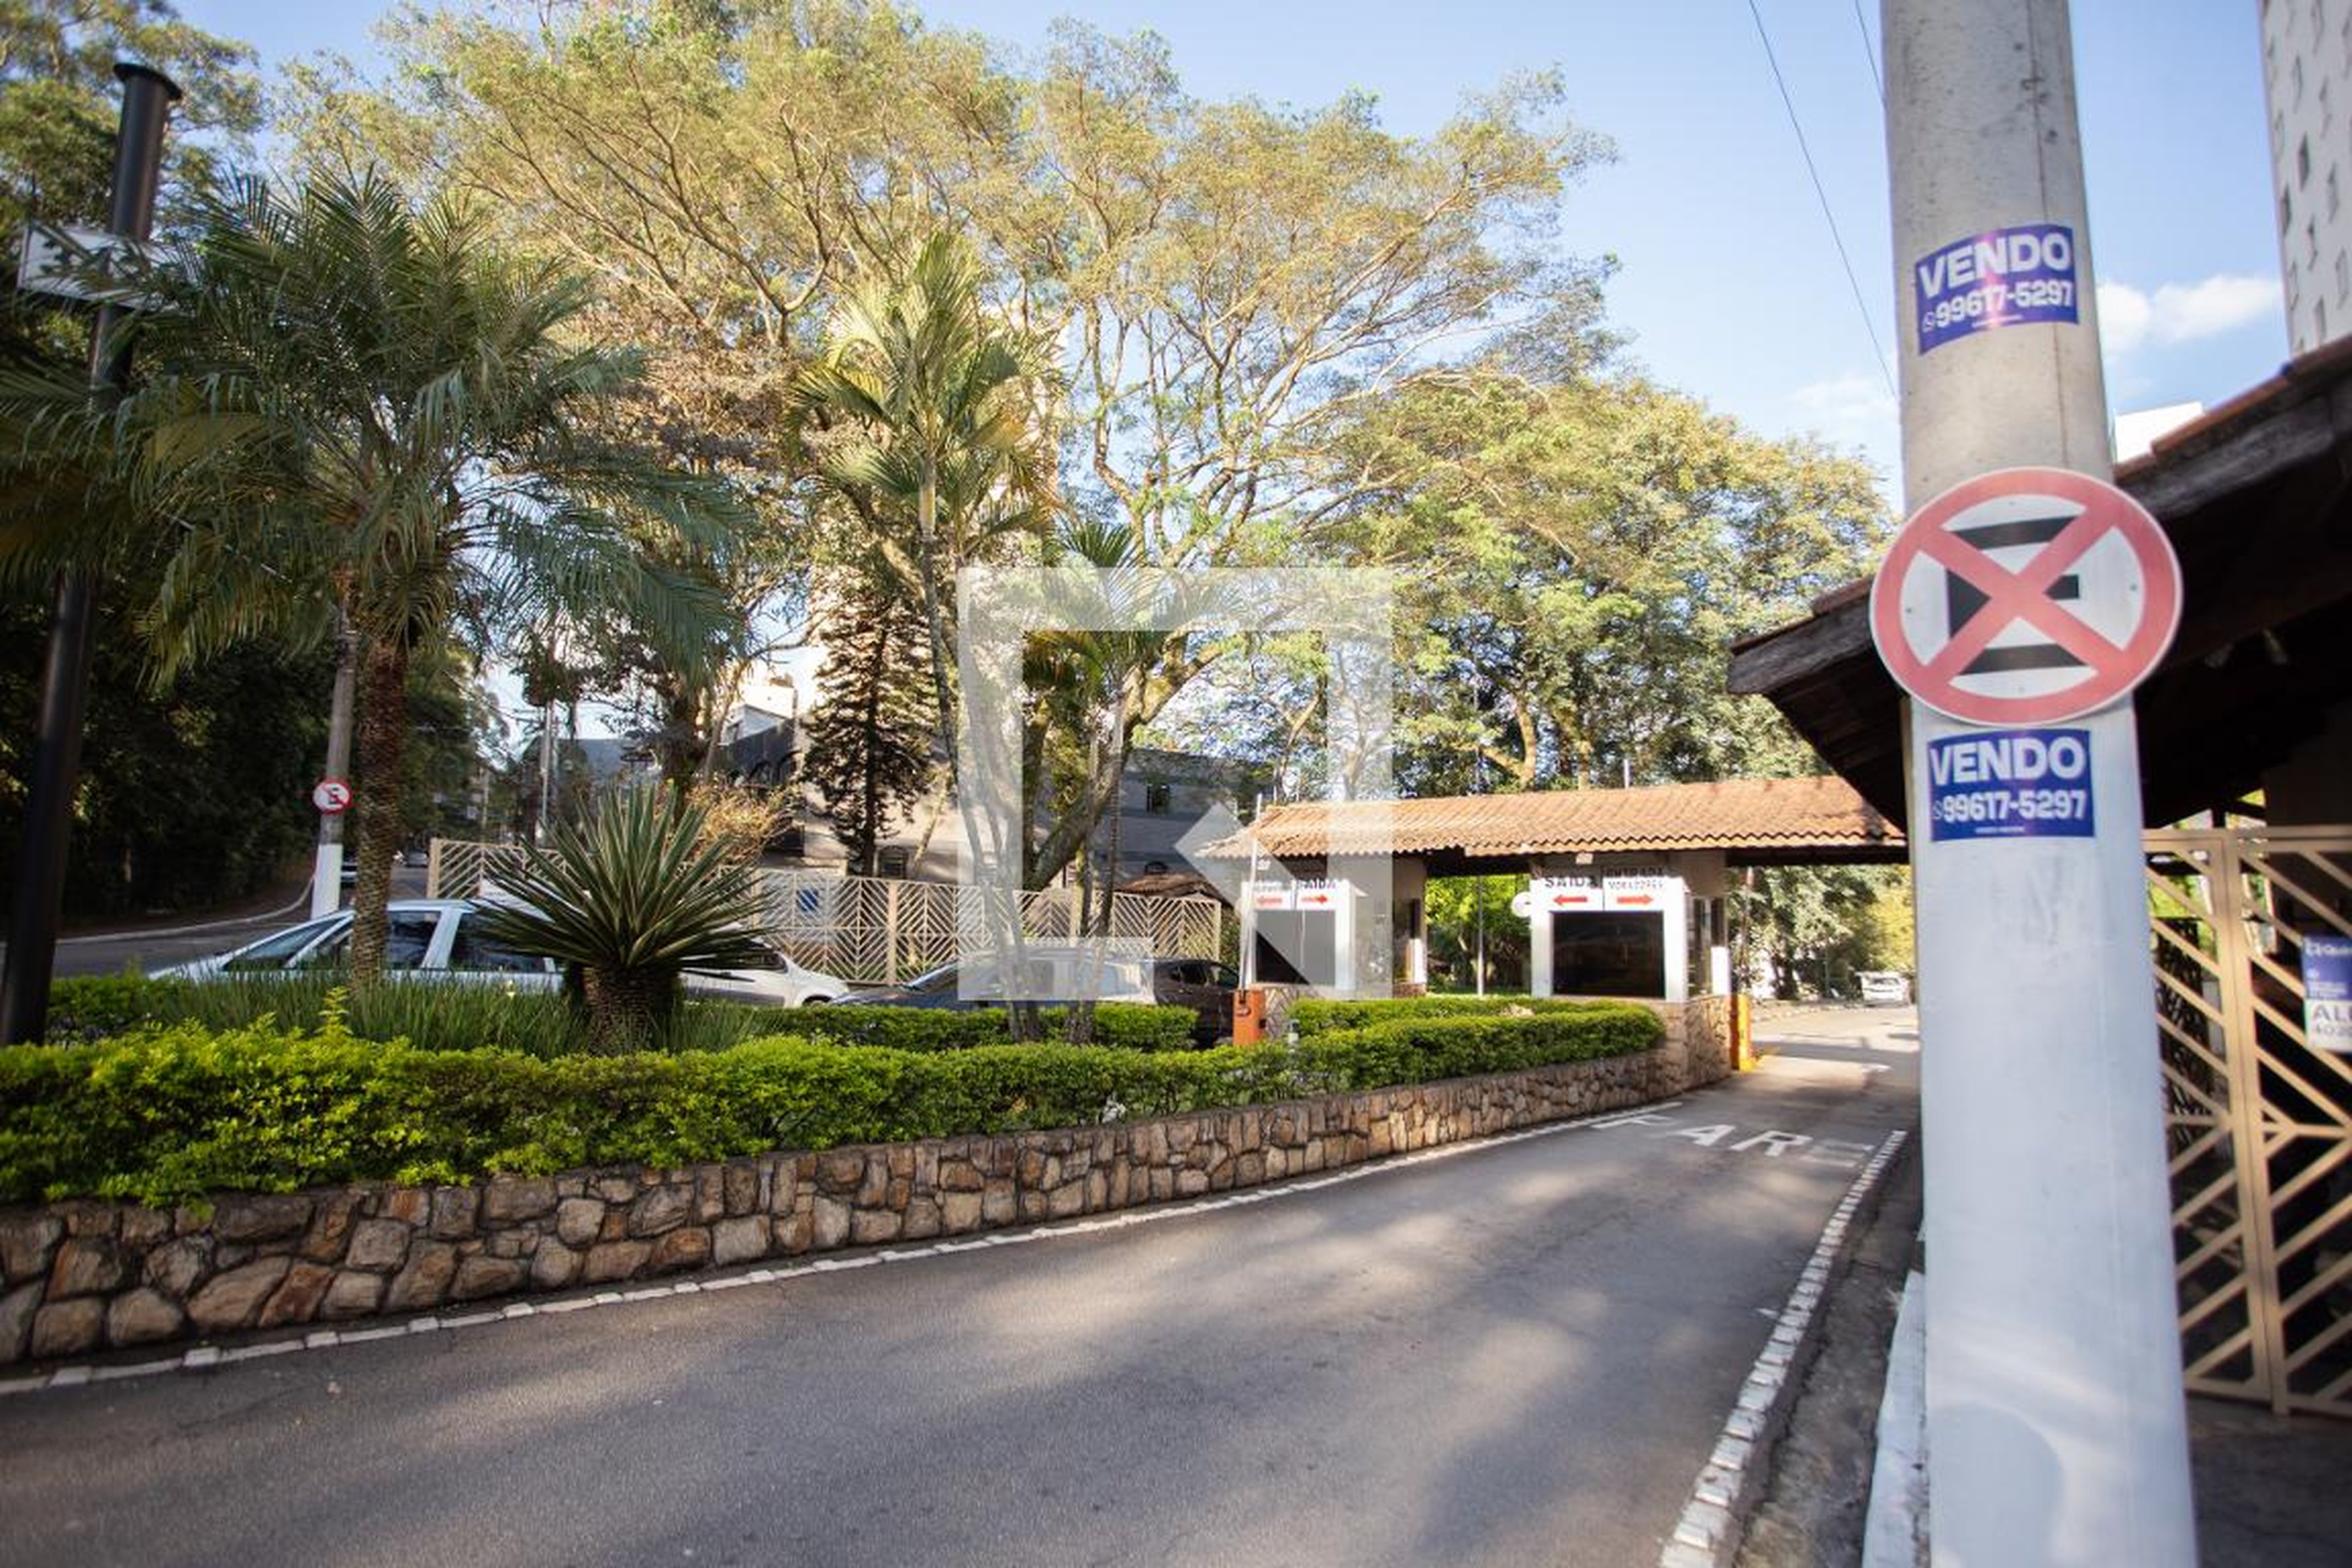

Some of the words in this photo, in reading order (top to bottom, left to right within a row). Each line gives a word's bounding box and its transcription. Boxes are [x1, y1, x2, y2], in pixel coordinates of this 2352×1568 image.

[1920, 232, 2070, 298] VENDO
[1929, 736, 2086, 786] VENDO
[1943, 789, 2087, 823] 99617-5297
